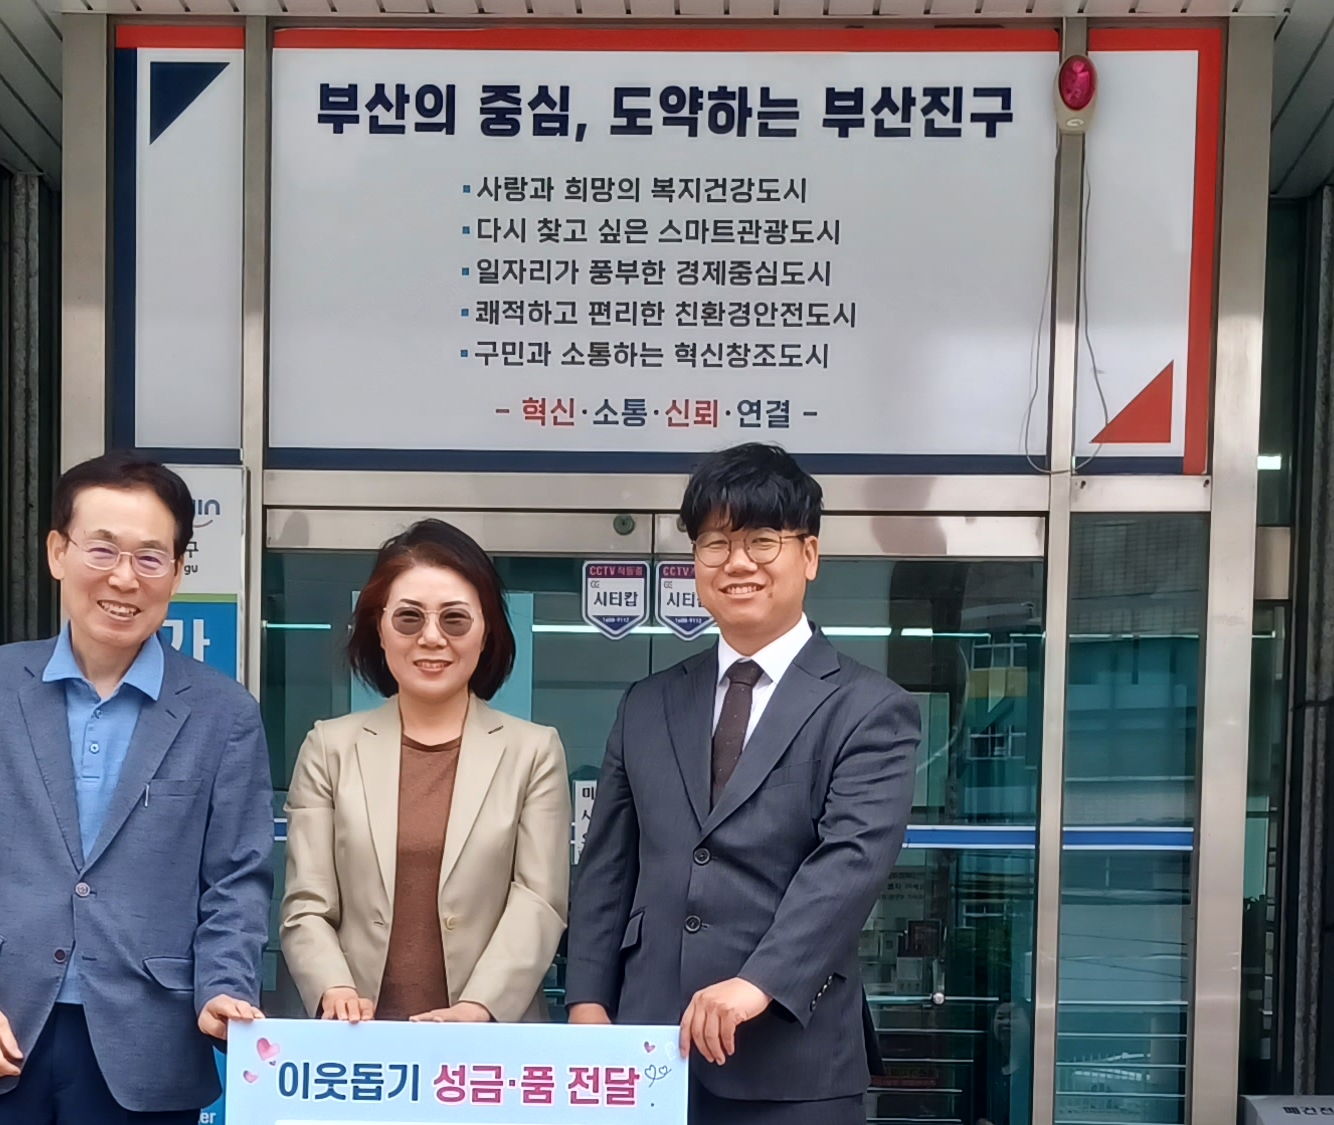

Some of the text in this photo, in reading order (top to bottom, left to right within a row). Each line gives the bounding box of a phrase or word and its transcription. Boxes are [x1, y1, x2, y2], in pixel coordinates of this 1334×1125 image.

[317, 83, 1014, 142] 부산의 중심, 도약하는 부산진구
[476, 177, 808, 203] 사랑과 희망의 복지건강도시
[476, 217, 841, 245] 다시 찾고 싶은 스마트관광도시
[476, 258, 832, 287] 일자리가 풍부한 경제중심도시
[475, 300, 857, 328] 쾌적하고 편리한 친환경안전도시
[474, 341, 829, 369] 구민과 소통하는 혁신창조도시
[589, 565, 615, 576] CCTV
[662, 566, 689, 577] CCTV
[593, 591, 639, 608] 시티캅
[278, 1062, 641, 1106] 이웃돕기 성금·품 전달
